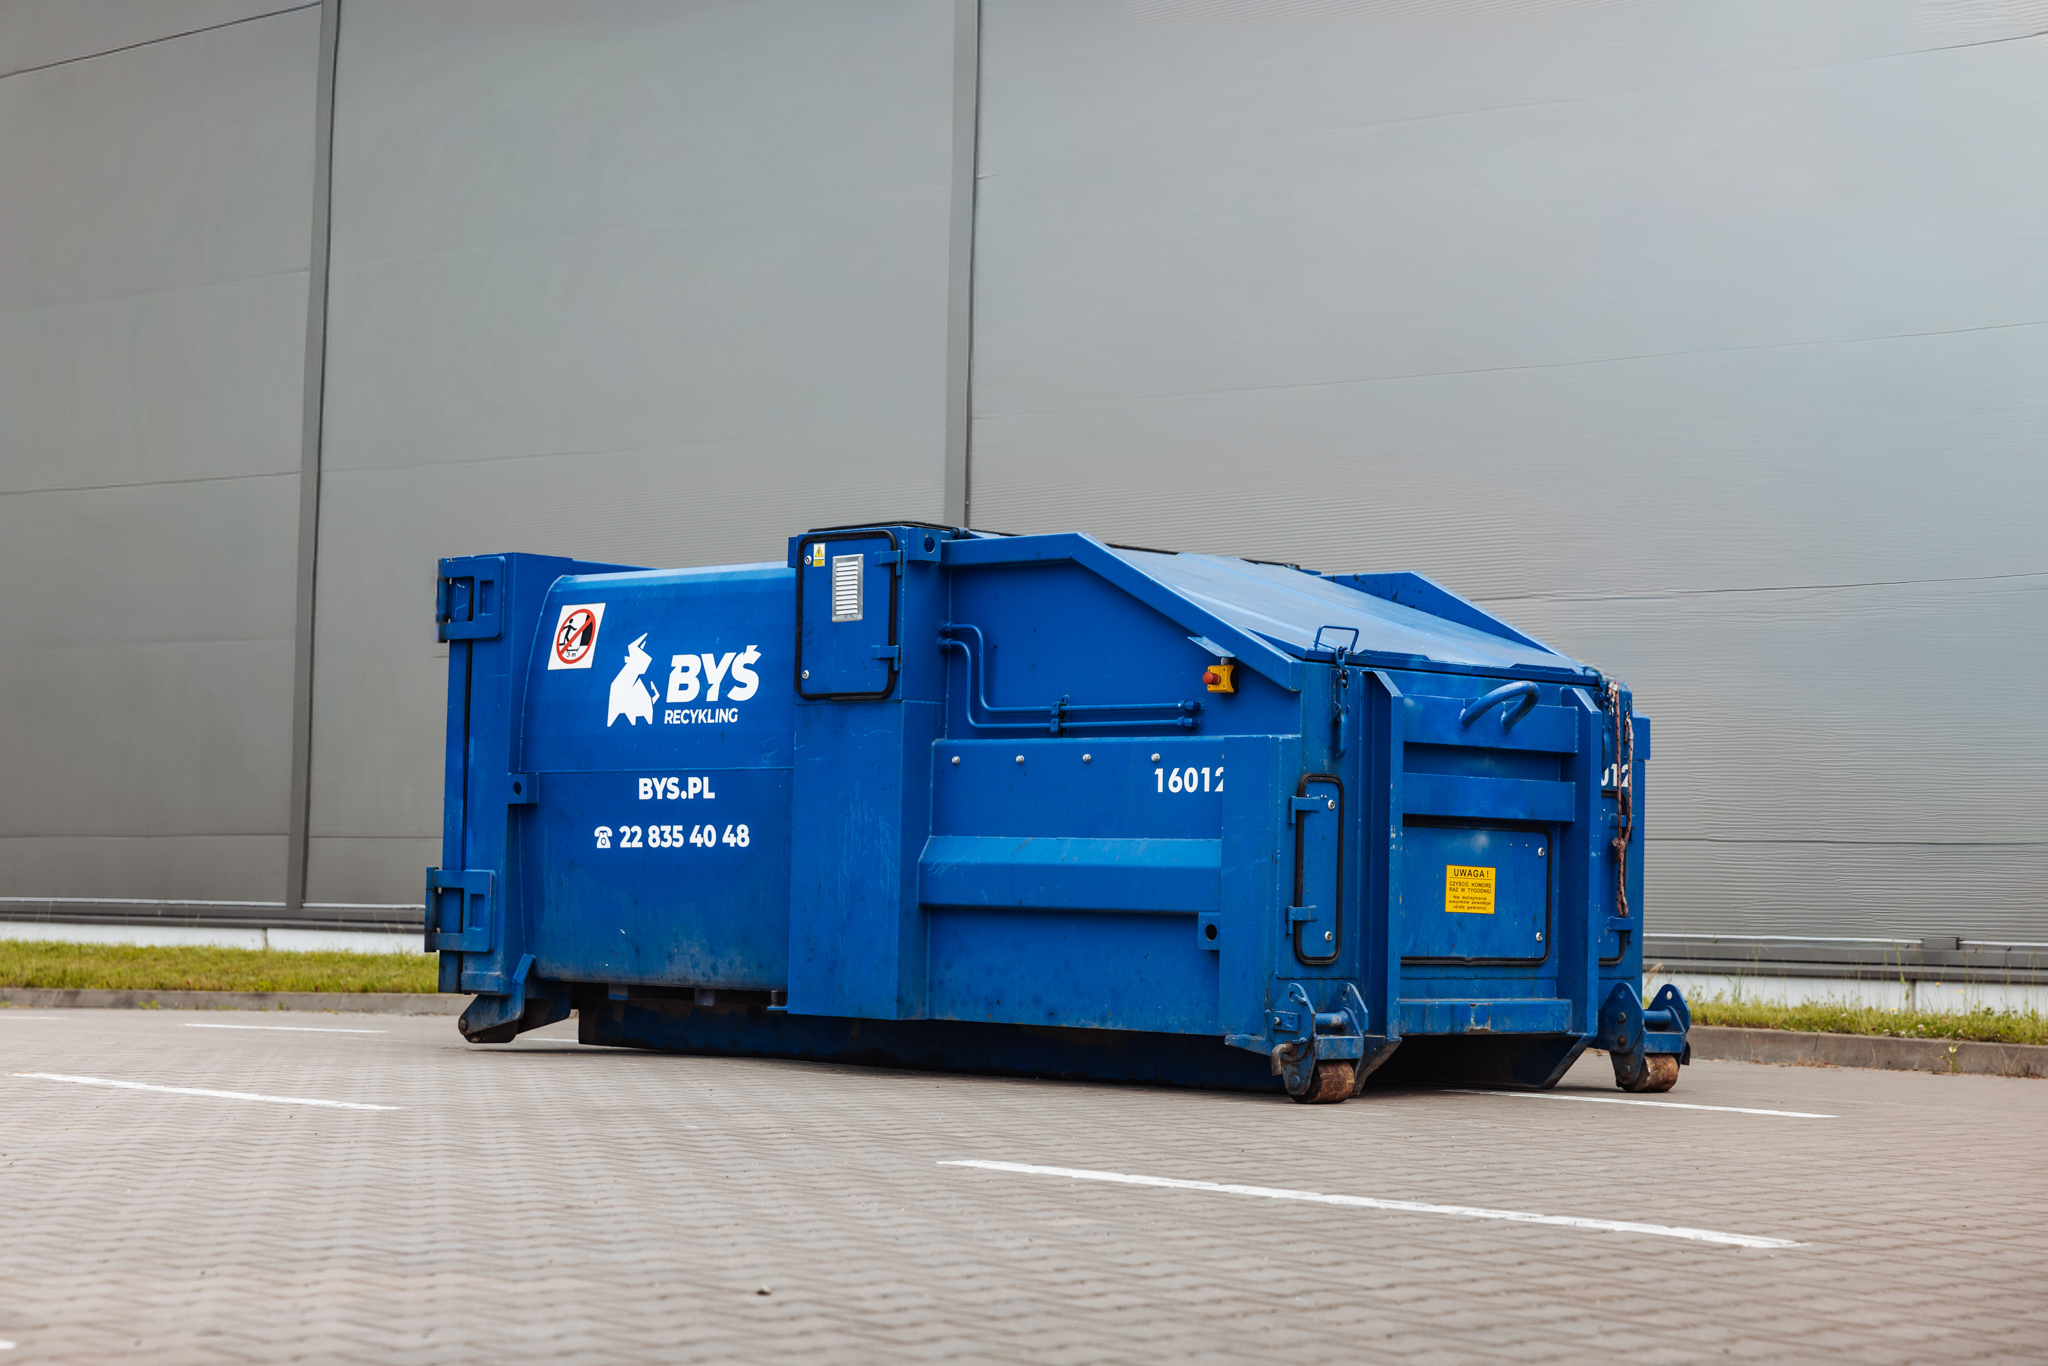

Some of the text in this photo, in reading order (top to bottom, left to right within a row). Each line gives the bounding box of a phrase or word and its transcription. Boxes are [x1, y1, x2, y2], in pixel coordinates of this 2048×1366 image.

[664, 708, 738, 724] RECYKLING
[638, 776, 715, 800] BYS.PL
[1154, 766, 1224, 793] 16012
[619, 824, 750, 848] 22 835 40 48
